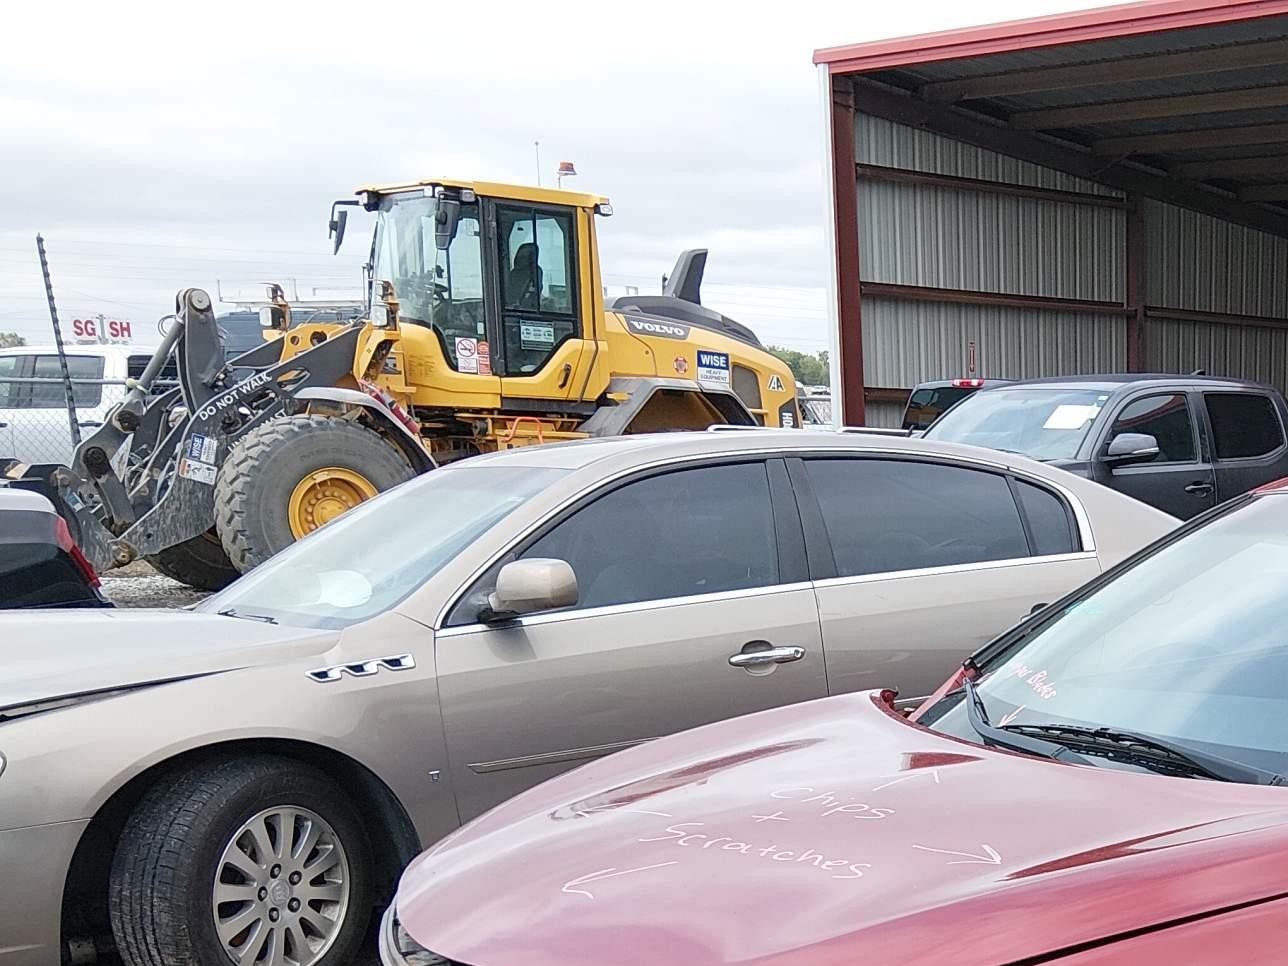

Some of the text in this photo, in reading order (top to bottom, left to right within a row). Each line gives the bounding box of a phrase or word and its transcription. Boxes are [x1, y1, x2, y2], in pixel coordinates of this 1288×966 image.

[109, 320, 132, 338] SH
[630, 320, 685, 337] VOLVO
[700, 354, 727, 367] WISE
[199, 372, 273, 421] DO NOT WALK
[191, 436, 204, 458] WISE
[770, 786, 896, 821] Chips
[639, 822, 873, 880] Scratches
